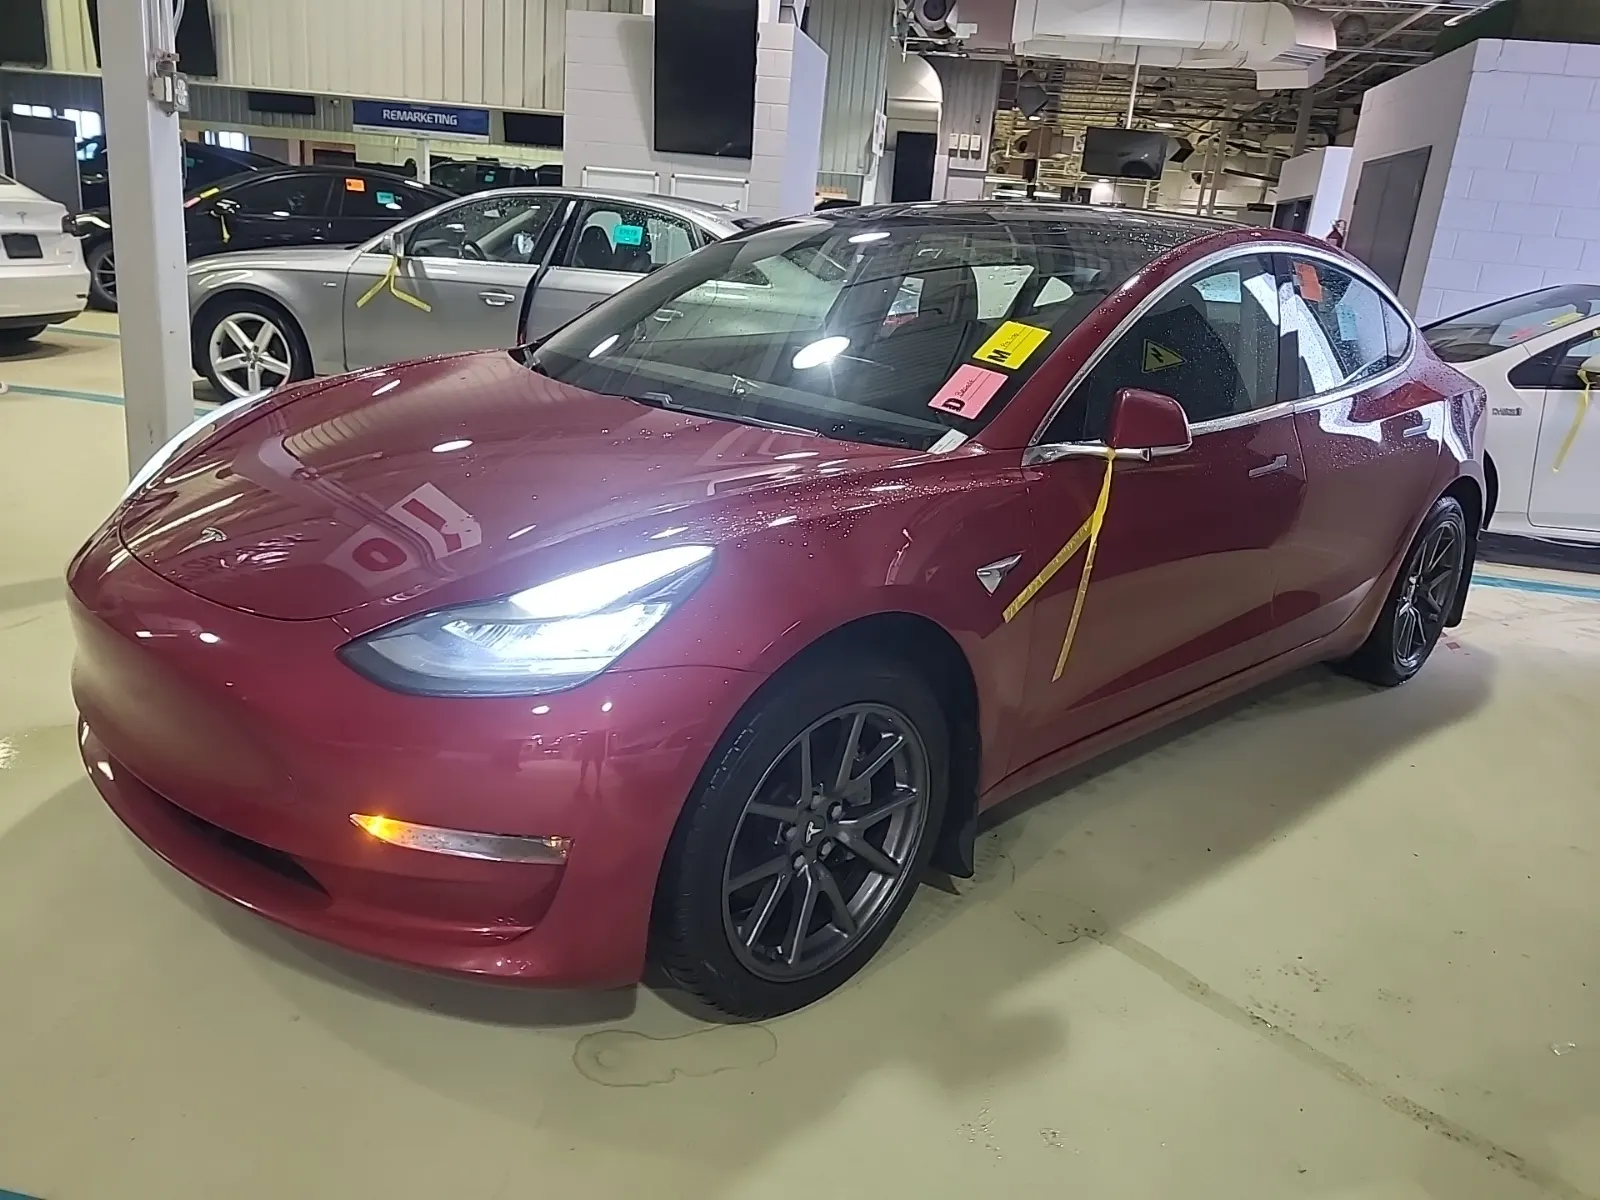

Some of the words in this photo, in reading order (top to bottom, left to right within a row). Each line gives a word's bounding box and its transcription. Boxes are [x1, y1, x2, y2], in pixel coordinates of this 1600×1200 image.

[382, 109, 458, 126] REMARKETING
[986, 348, 1012, 363] M
[941, 397, 966, 412] D
